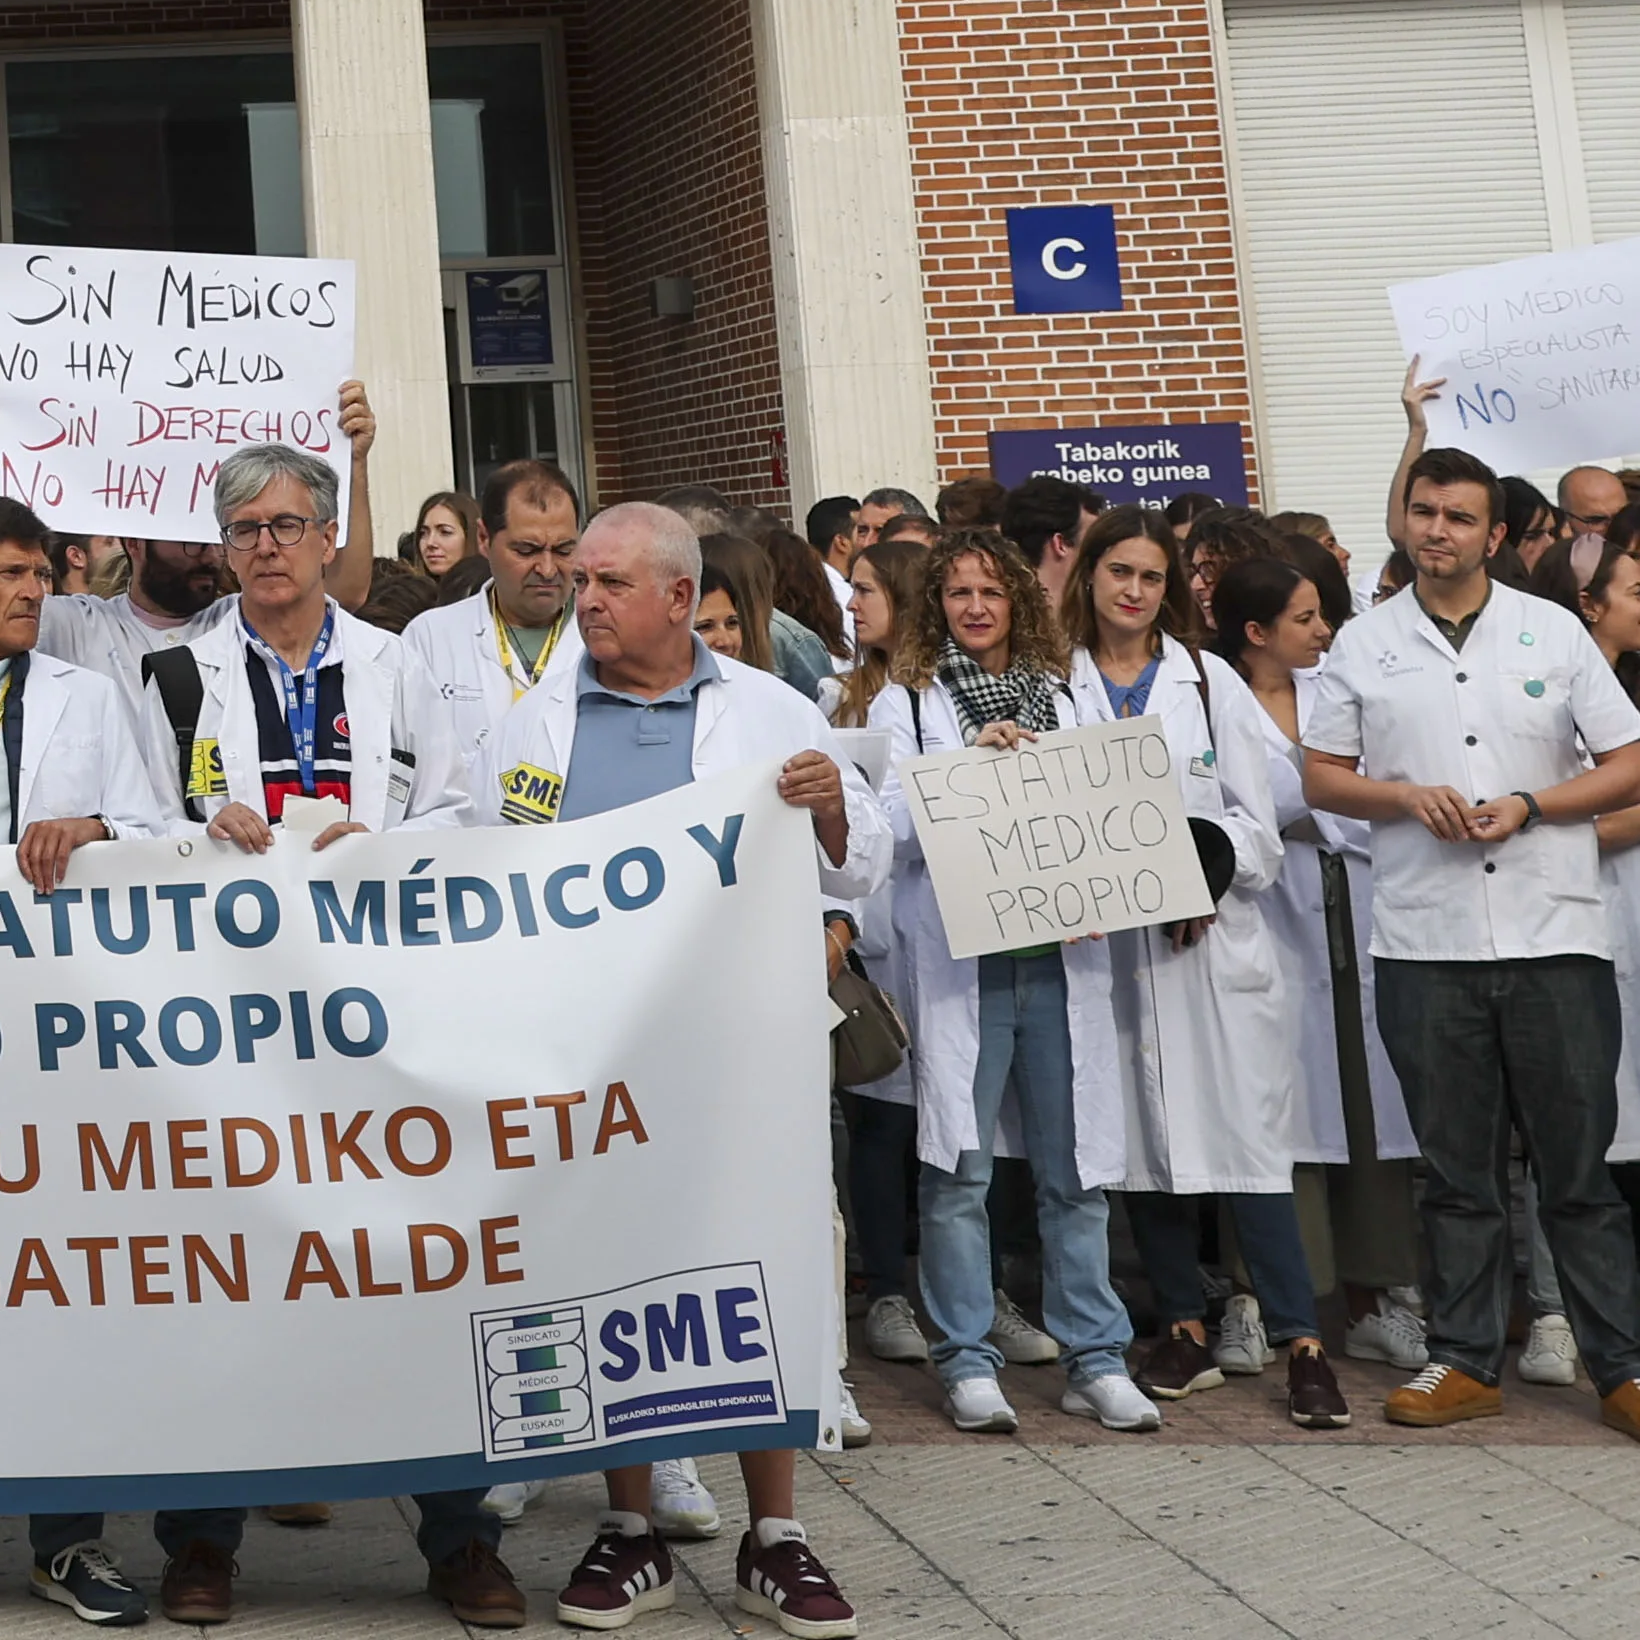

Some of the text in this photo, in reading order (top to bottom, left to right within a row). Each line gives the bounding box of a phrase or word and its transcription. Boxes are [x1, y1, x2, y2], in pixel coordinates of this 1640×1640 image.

[1041, 237, 1087, 281] C
[1424, 303, 1488, 350] SOY
[65, 341, 134, 394] HAY
[165, 346, 284, 388] SALUD
[127, 400, 332, 452] DERECHOS
[1455, 382, 1516, 430] NO
[1055, 439, 1181, 462] Tabakorik
[1131, 463, 1211, 487] gunea
[2, 451, 64, 509] NO
[93, 458, 166, 515] HAY
[510, 769, 561, 810] SME
[912, 733, 1171, 824] ESTATUTO
[308, 846, 666, 947] MÉDICO
[686, 813, 745, 888] Y
[986, 868, 1164, 940] PROPIO
[35, 986, 389, 1071] PROPIO
[76, 1105, 453, 1193] MEDIKO
[485, 1080, 650, 1171] ETA
[283, 1214, 525, 1302] ALDE
[507, 1329, 562, 1345] SINDICATO
[598, 1286, 768, 1382] SME
[518, 1373, 559, 1388] MÉDICO
[520, 1418, 565, 1432] EUSKADI
[608, 1394, 773, 1425] EUSKADIKO SENDAGILEEN SINDIKATUA
